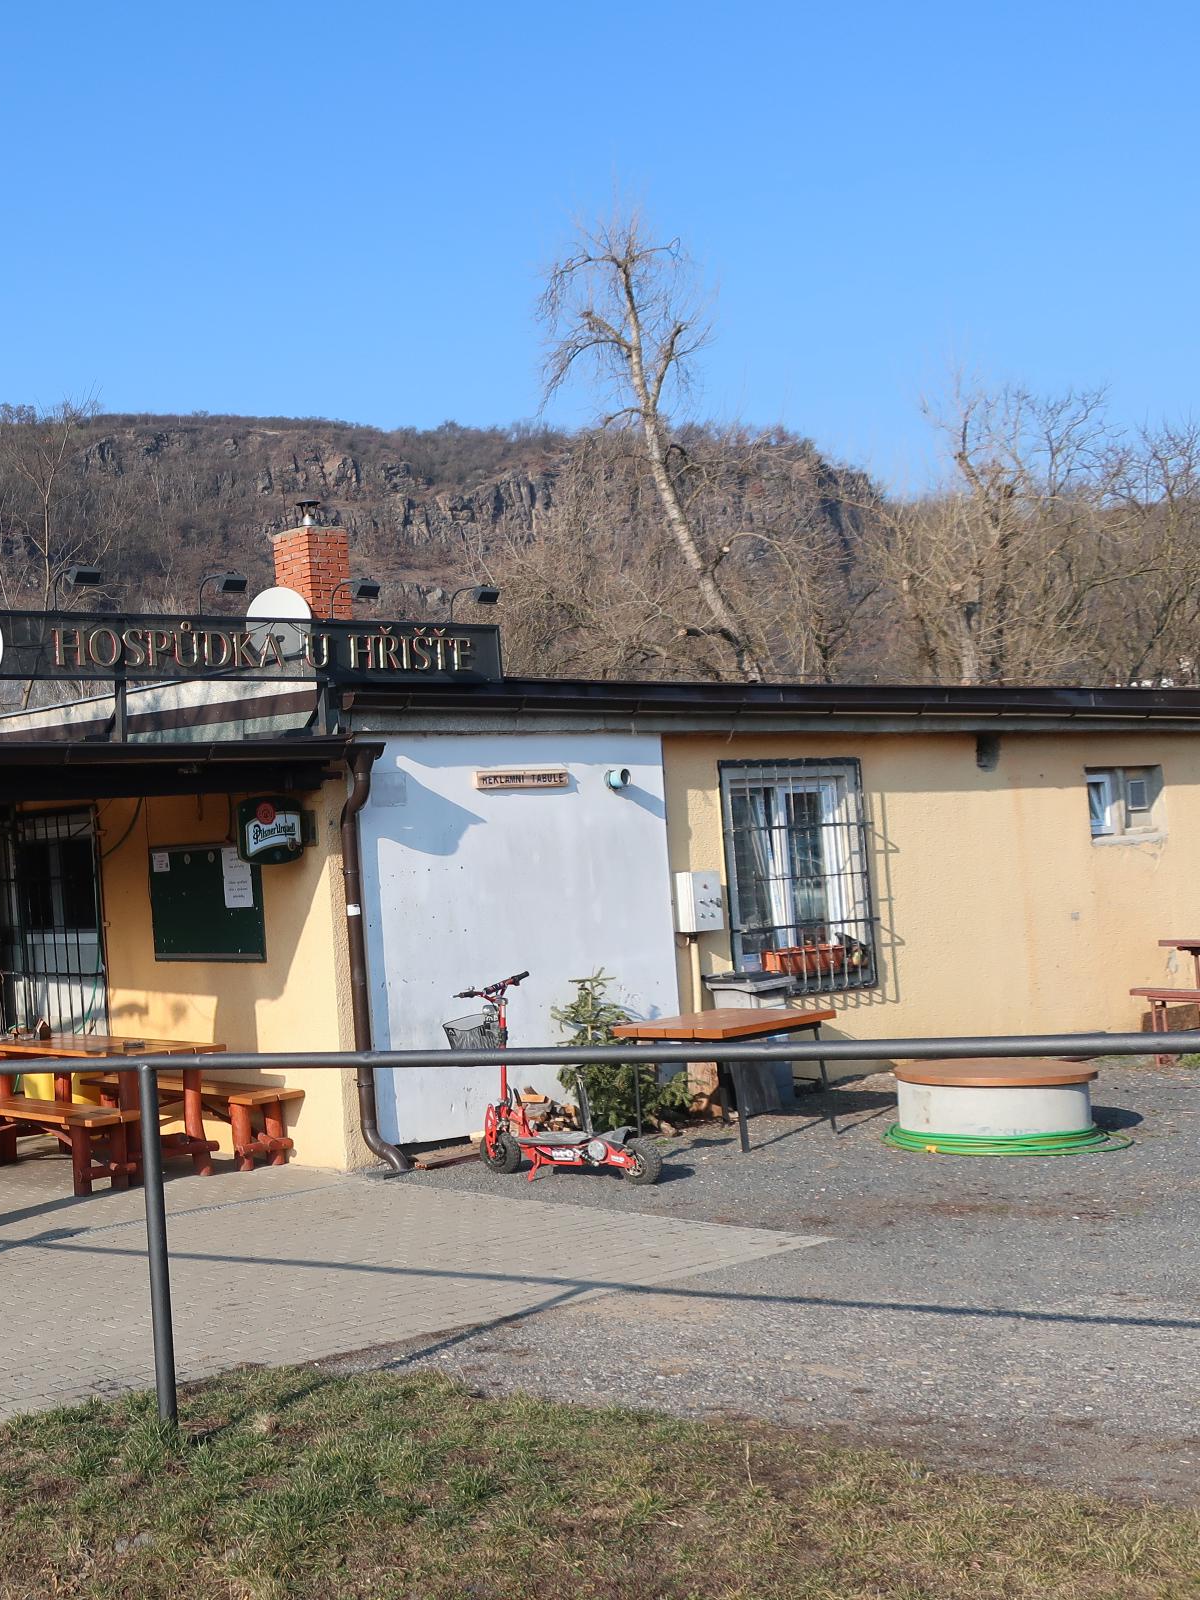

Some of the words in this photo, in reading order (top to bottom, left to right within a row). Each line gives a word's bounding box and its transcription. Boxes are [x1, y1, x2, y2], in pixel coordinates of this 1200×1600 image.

[51, 620, 286, 668] HOSPŮDKA
[304, 633, 331, 668] U
[531, 773, 564, 783] TABULE
[253, 823, 277, 845] Pilsner
